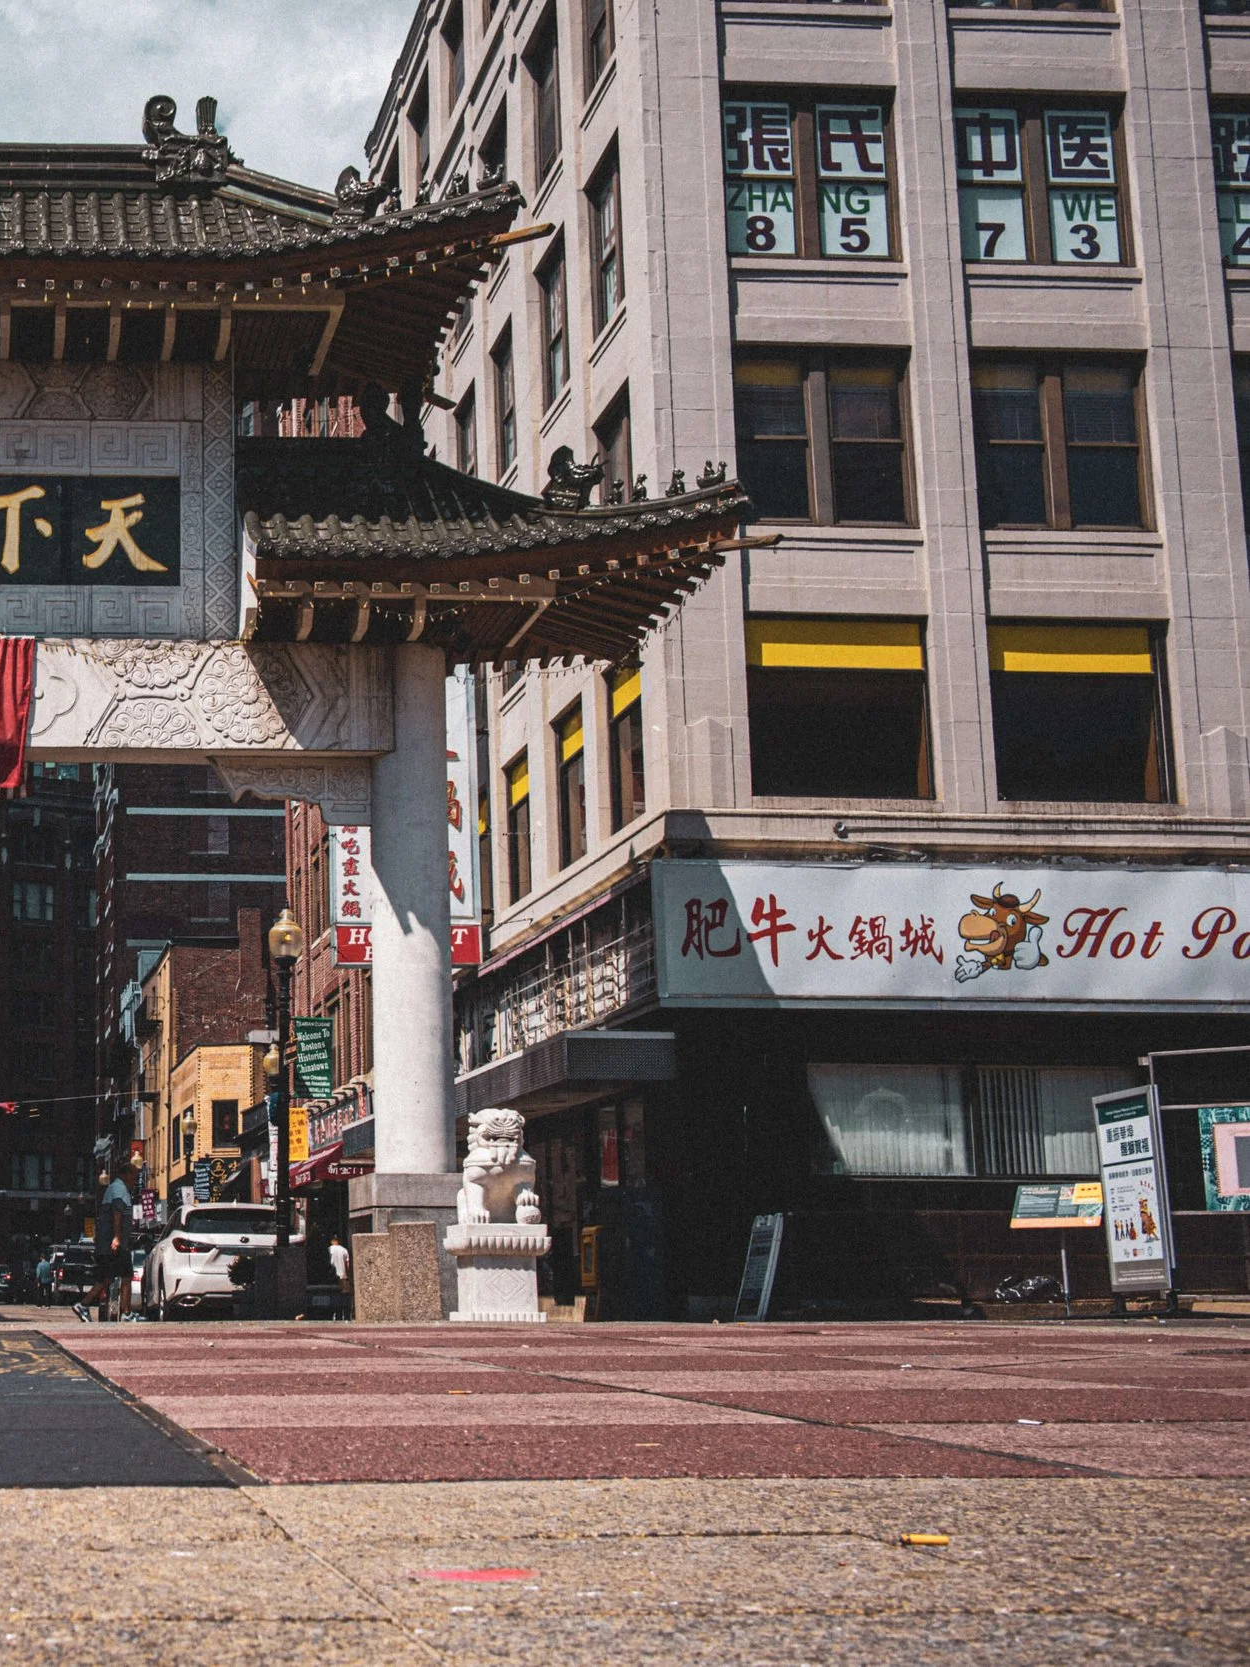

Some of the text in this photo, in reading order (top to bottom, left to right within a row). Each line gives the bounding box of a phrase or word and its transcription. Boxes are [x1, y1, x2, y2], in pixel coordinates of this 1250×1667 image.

[745, 215, 777, 252] 8
[839, 217, 871, 253] 5
[975, 222, 1006, 258] 7
[1070, 223, 1101, 260] 3
[680, 893, 945, 968] 肥牛火鍋城
[1056, 905, 1165, 961] Hot
[297, 1028, 330, 1041] Welcome To
[297, 1050, 328, 1063] Historical
[297, 1062, 329, 1074] Chinatown
